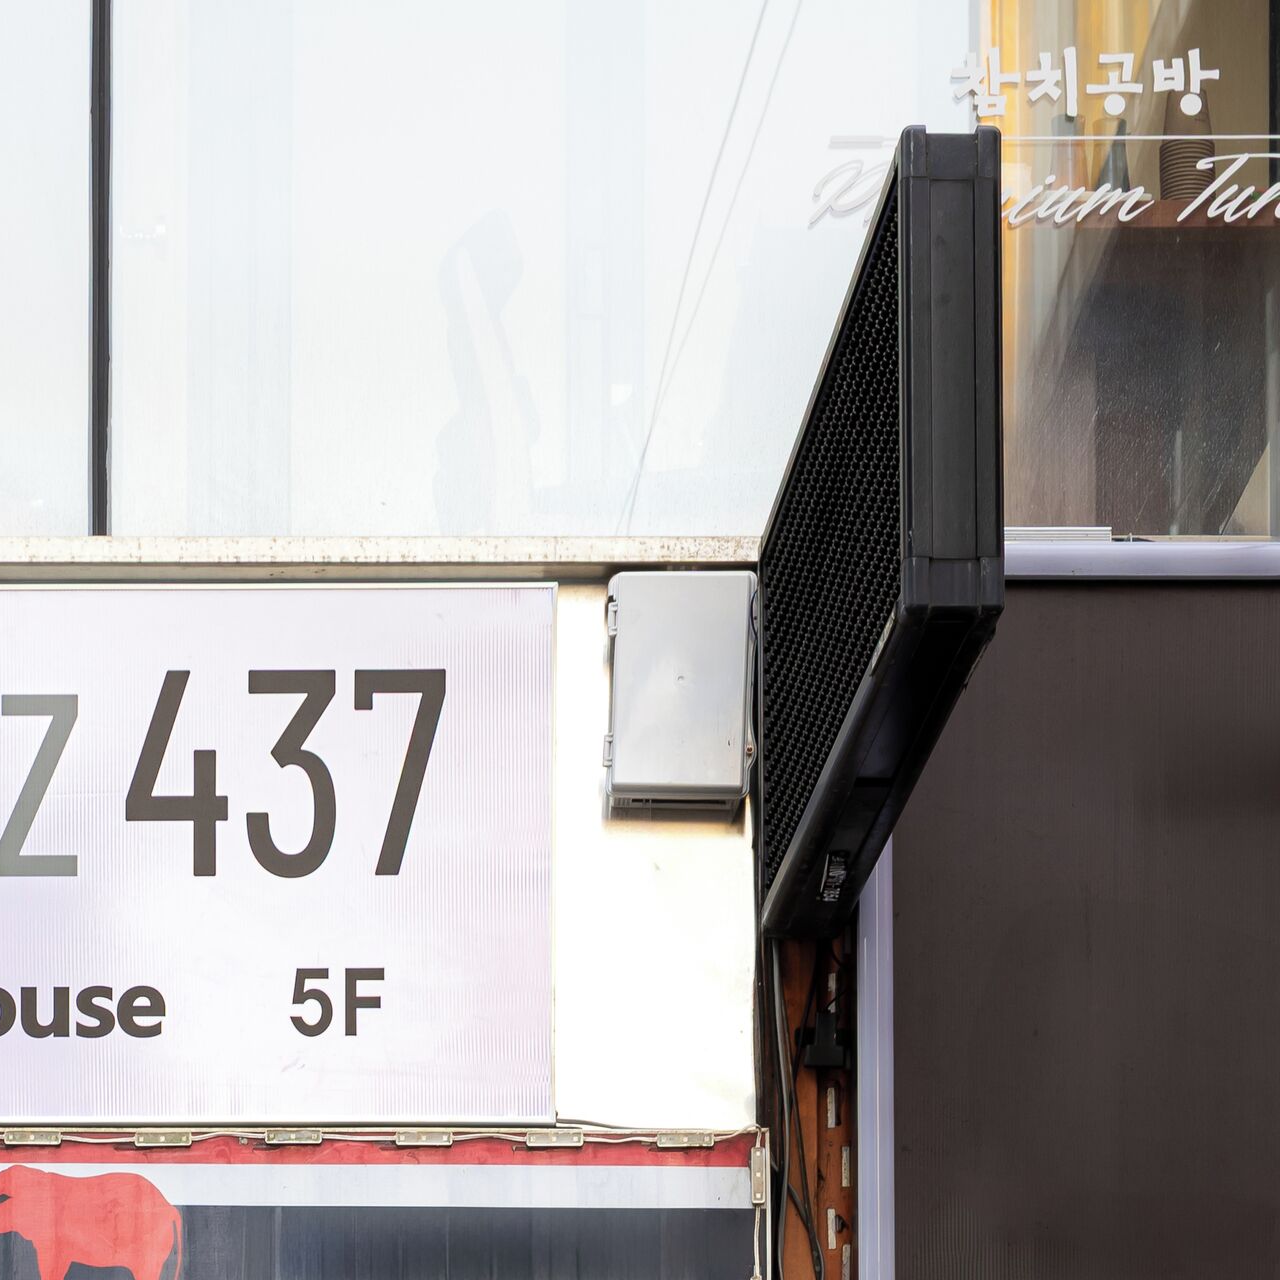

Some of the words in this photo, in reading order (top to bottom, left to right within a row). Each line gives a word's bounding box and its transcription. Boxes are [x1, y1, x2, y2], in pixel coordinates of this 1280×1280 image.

[951, 47, 1219, 116] 참치공방
[125, 669, 448, 879] 437
[289, 967, 386, 1037] 5F
